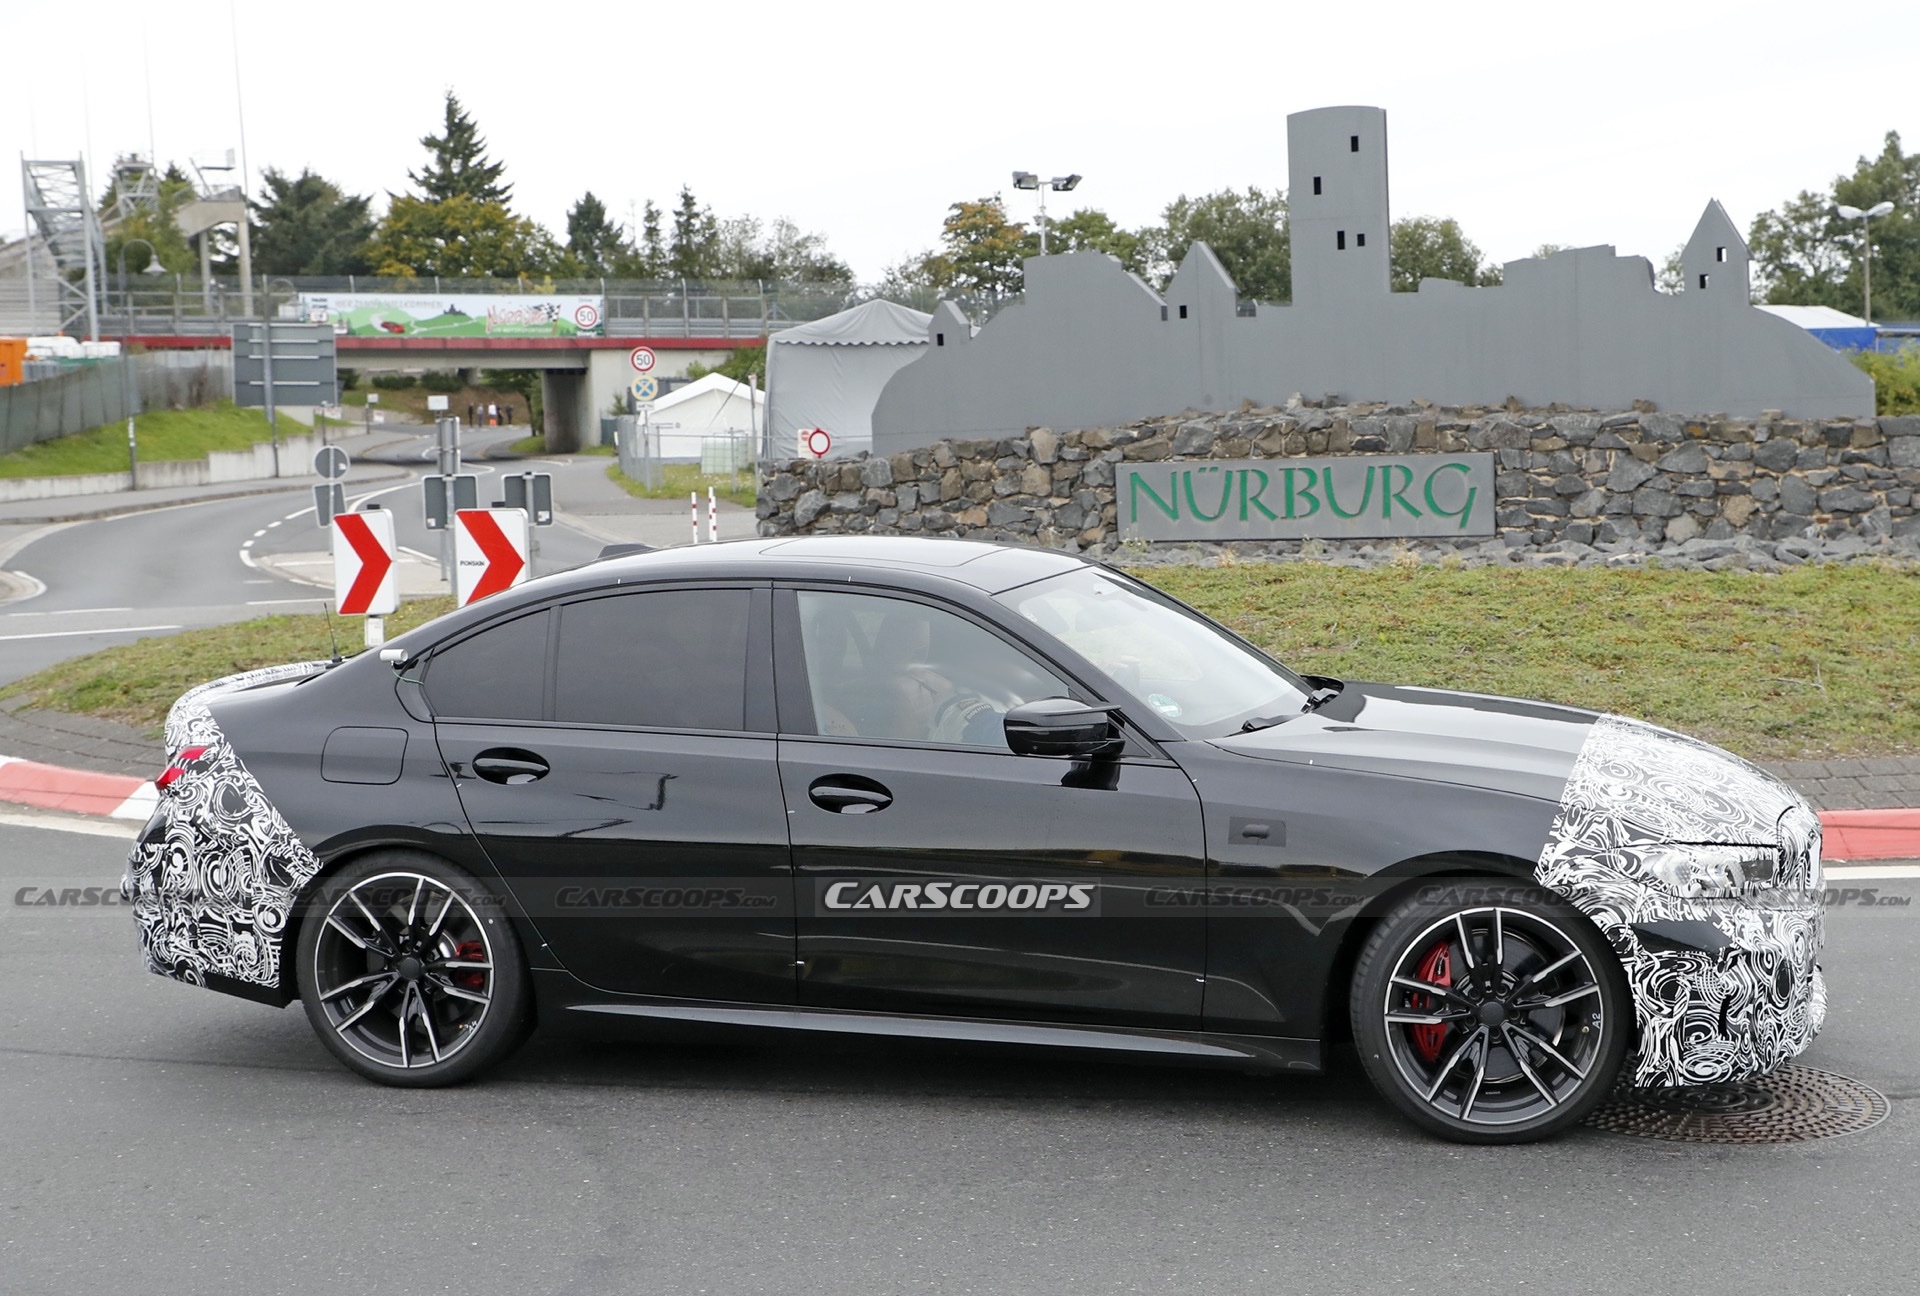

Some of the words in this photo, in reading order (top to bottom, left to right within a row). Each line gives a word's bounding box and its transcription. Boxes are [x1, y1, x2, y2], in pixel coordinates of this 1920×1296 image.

[579, 311, 594, 322] 50
[636, 354, 651, 366] 50
[1129, 462, 1477, 530] NÜRBURG
